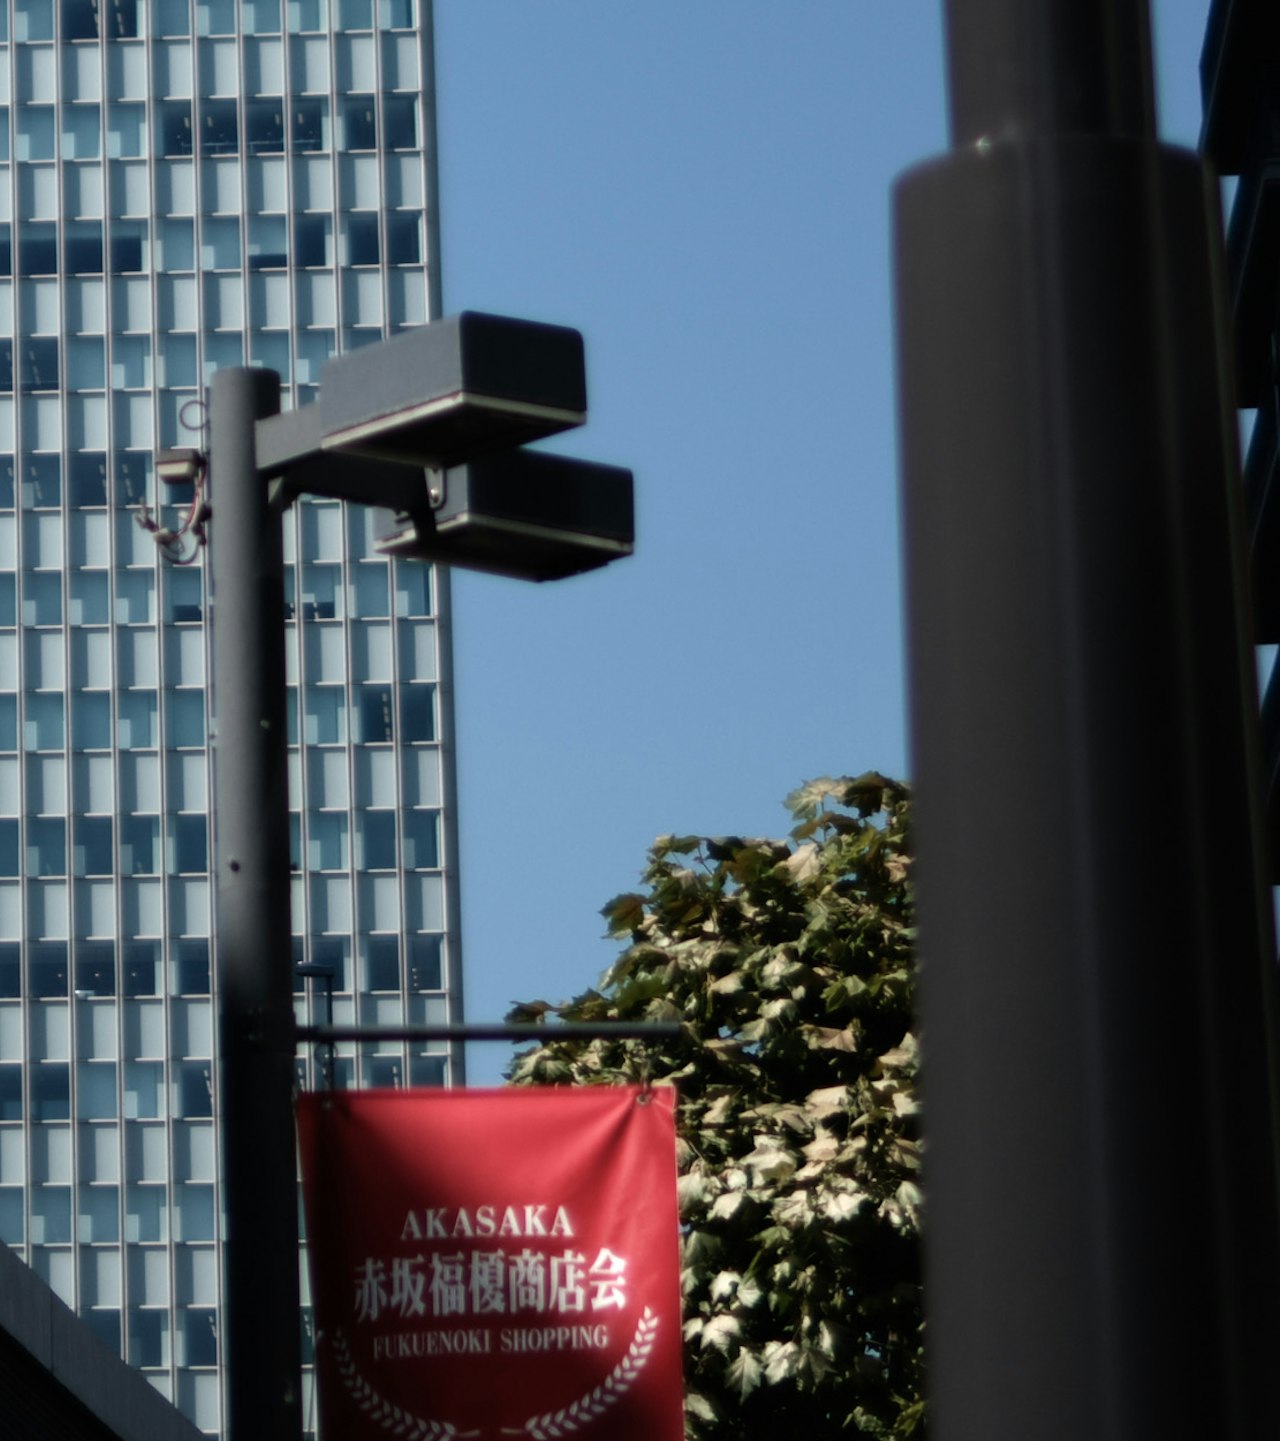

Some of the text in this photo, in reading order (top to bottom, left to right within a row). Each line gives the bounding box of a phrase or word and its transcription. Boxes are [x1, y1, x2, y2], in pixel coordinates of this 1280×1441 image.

[400, 1204, 575, 1241] AKASAKA
[353, 1246, 628, 1323] 赤坂福榎商店会
[372, 1322, 610, 1361] FUKUENOKI SHOPPING
